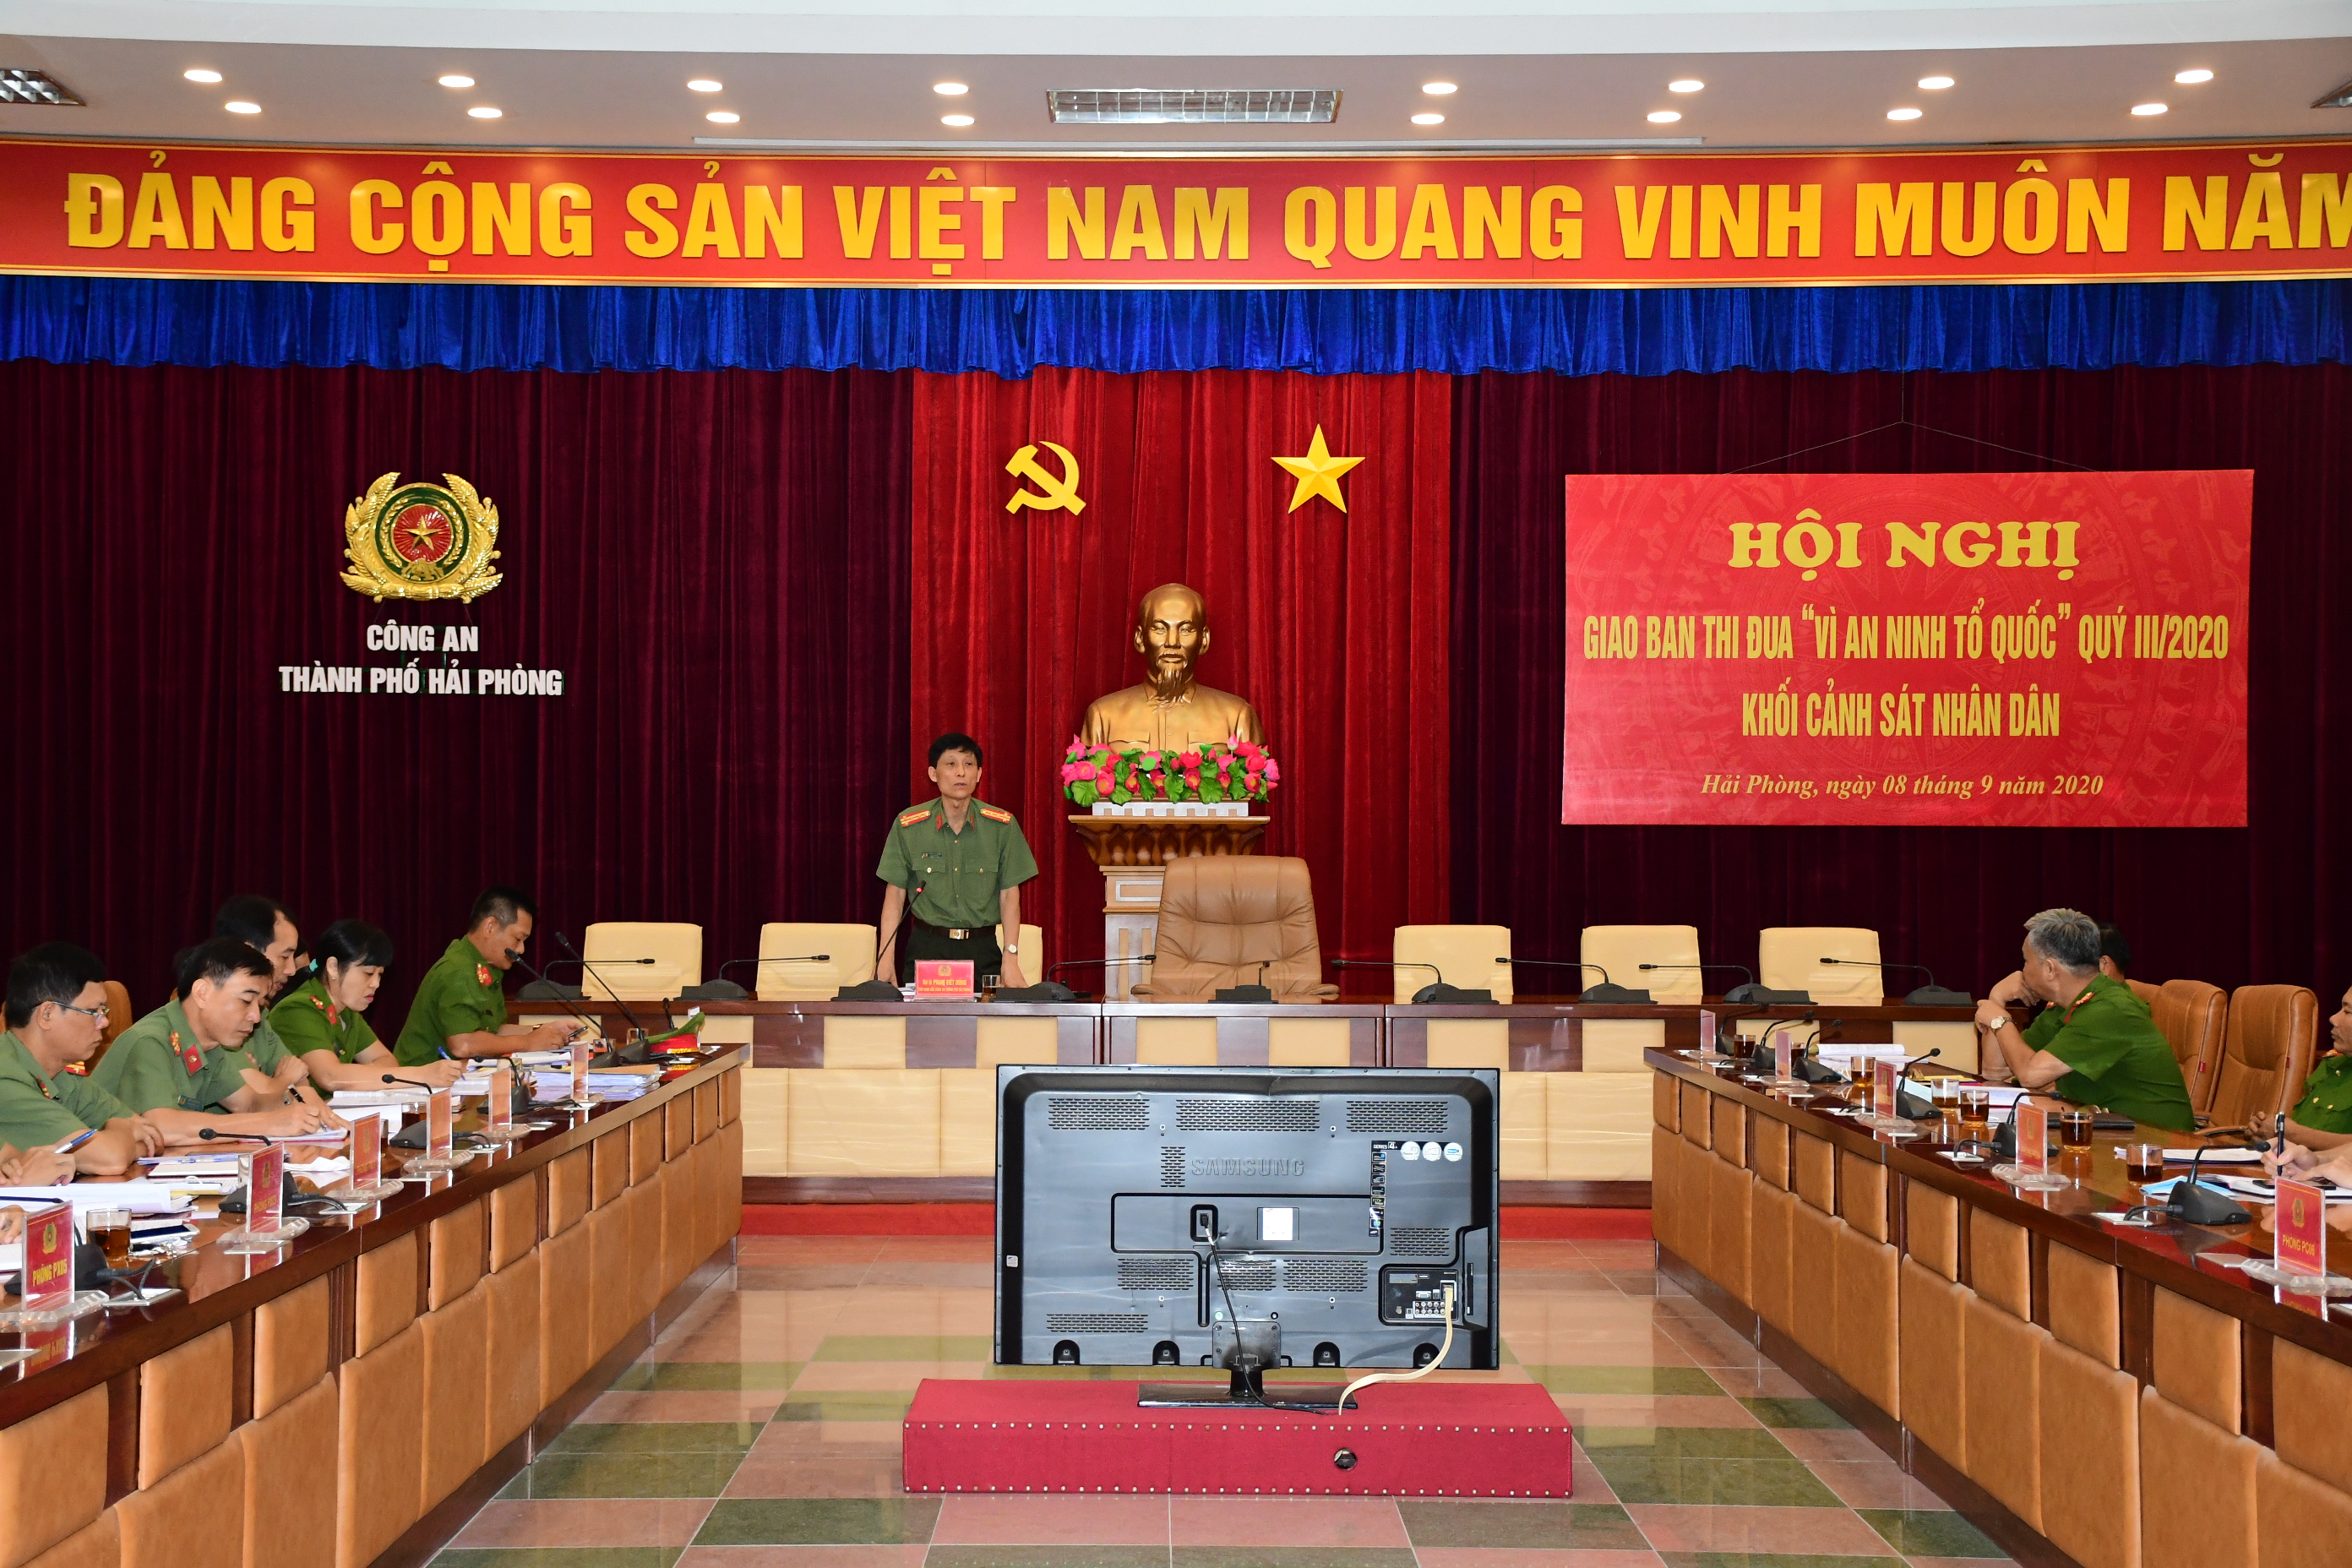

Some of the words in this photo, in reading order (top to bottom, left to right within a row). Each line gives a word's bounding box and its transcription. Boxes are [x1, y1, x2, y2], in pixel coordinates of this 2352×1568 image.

[65, 150, 316, 253] ĐẢNG
[350, 161, 594, 272] CỘNG
[625, 161, 803, 259] SẢN
[833, 167, 1016, 275] VIỆT
[1048, 185, 1250, 260] NAM
[1284, 183, 1583, 269] QUANG
[1614, 183, 1822, 259] VINH
[1854, 159, 2131, 258] MUÔN
[2163, 153, 2352, 252] NĂM
[1728, 508, 1863, 581] HỘI
[1885, 520, 2081, 581] NGHỊ
[367, 618, 435, 651] CÔNG
[442, 625, 479, 652] AN
[1583, 615, 1639, 659] GIAO
[1646, 615, 1696, 659] BAN
[1702, 615, 1740, 659] THI
[1745, 615, 1794, 659] ĐUA
[1843, 615, 1879, 659] AN
[1886, 615, 1946, 659] NINH
[1953, 597, 1985, 660] TỔ
[2078, 605, 2127, 664] QUÝ
[2134, 614, 2229, 659] III/2020
[278, 660, 362, 693] THÀNH
[370, 657, 420, 694] PHỐ
[428, 658, 471, 694] HẢI
[478, 663, 564, 696] PHÒNG
[1742, 677, 1799, 737] KHỐI
[1805, 678, 1872, 737] CẢNH
[1879, 683, 1926, 737] SÁT
[1932, 683, 2001, 737] NHÂN
[2009, 683, 2060, 737] DÂN
[1700, 775, 1741, 794] Hải
[1745, 774, 1819, 800] Phòng,
[1826, 775, 1876, 800] ngày
[1882, 775, 1908, 794] 08
[1913, 775, 1974, 800] tháng
[1981, 775, 1993, 794] 9
[1998, 776, 2045, 795] năm
[2051, 775, 2104, 795] 2020
[1191, 1158, 1304, 1177] SAMSUNG
[2282, 1233, 2301, 1251] PHÒNG
[32, 1263, 52, 1287] PHÒNG
